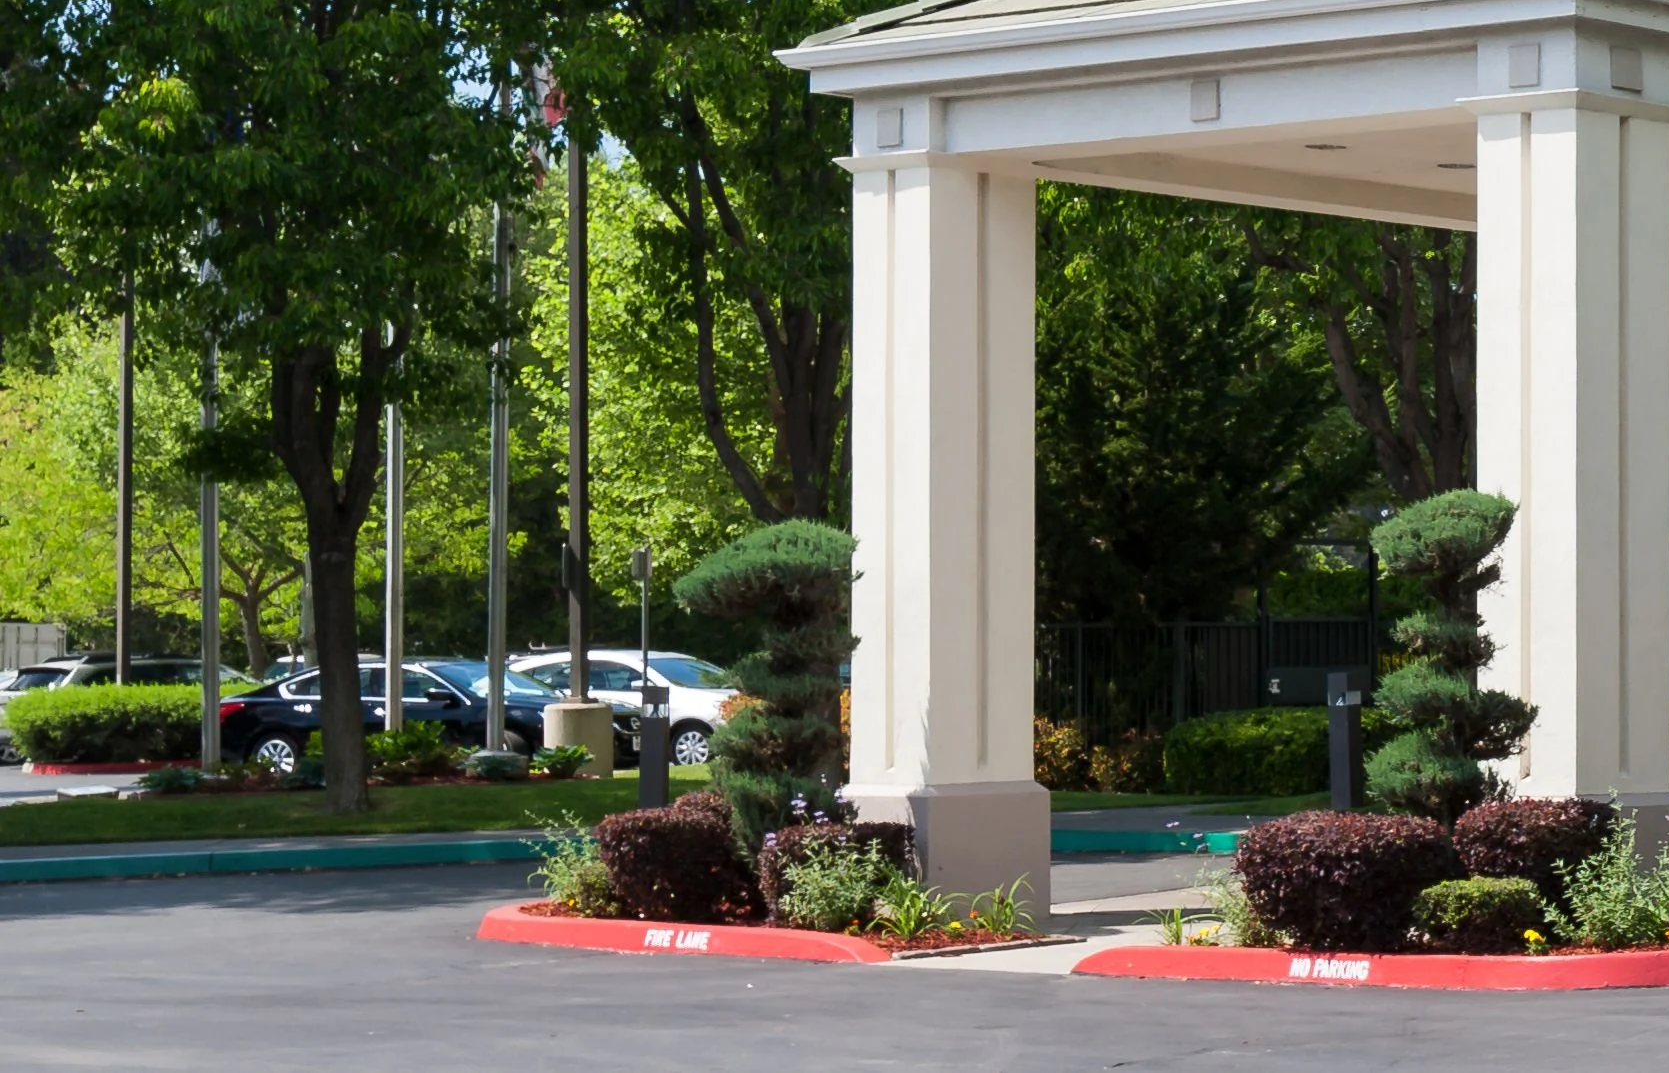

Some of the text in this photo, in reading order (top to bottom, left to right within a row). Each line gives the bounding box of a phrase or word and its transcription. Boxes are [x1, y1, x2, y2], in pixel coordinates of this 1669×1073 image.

[644, 929, 711, 950] FIRE LANE
[1289, 958, 1370, 980] NO PARKING
